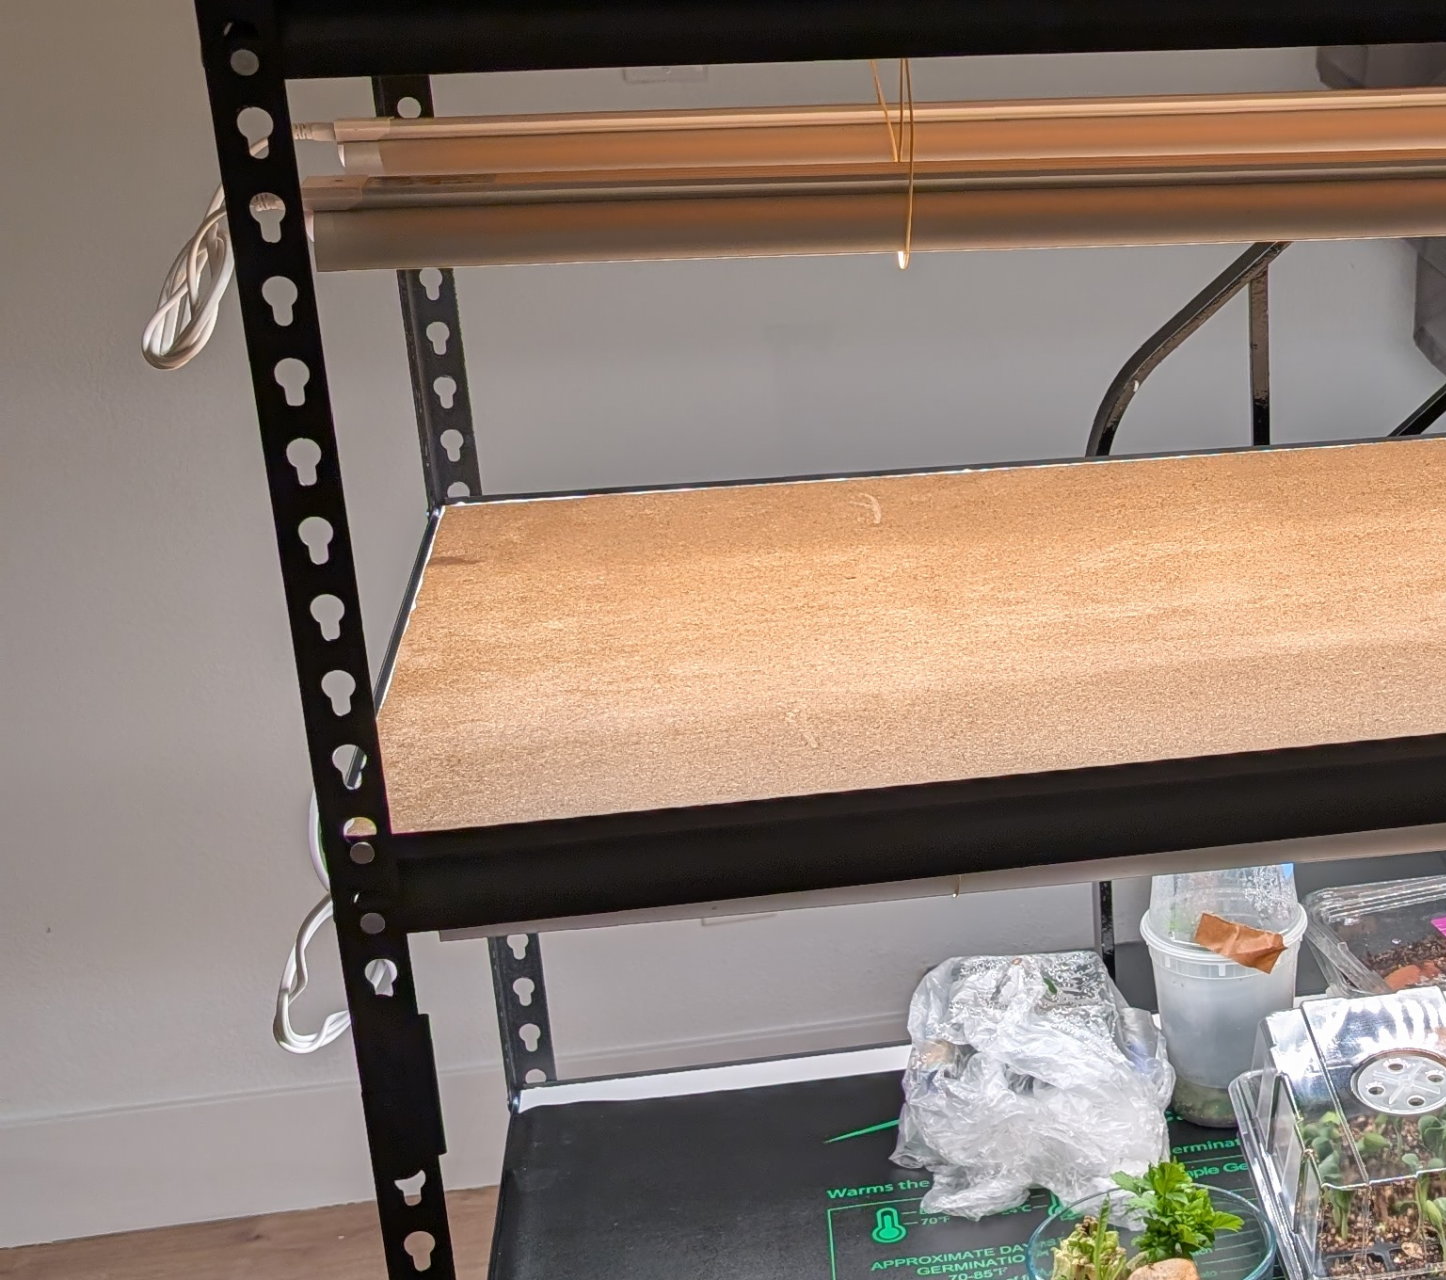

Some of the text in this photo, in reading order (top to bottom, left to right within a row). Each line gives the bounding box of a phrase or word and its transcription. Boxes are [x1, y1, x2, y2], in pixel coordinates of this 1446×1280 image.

[1171, 1138, 1241, 1154] erminat
[1223, 1162, 1249, 1173] Ge
[827, 1180, 930, 1199] Warms the
[871, 1247, 996, 1271] APPROXIMATE
[916, 1254, 1026, 1276] GERMINATIO
